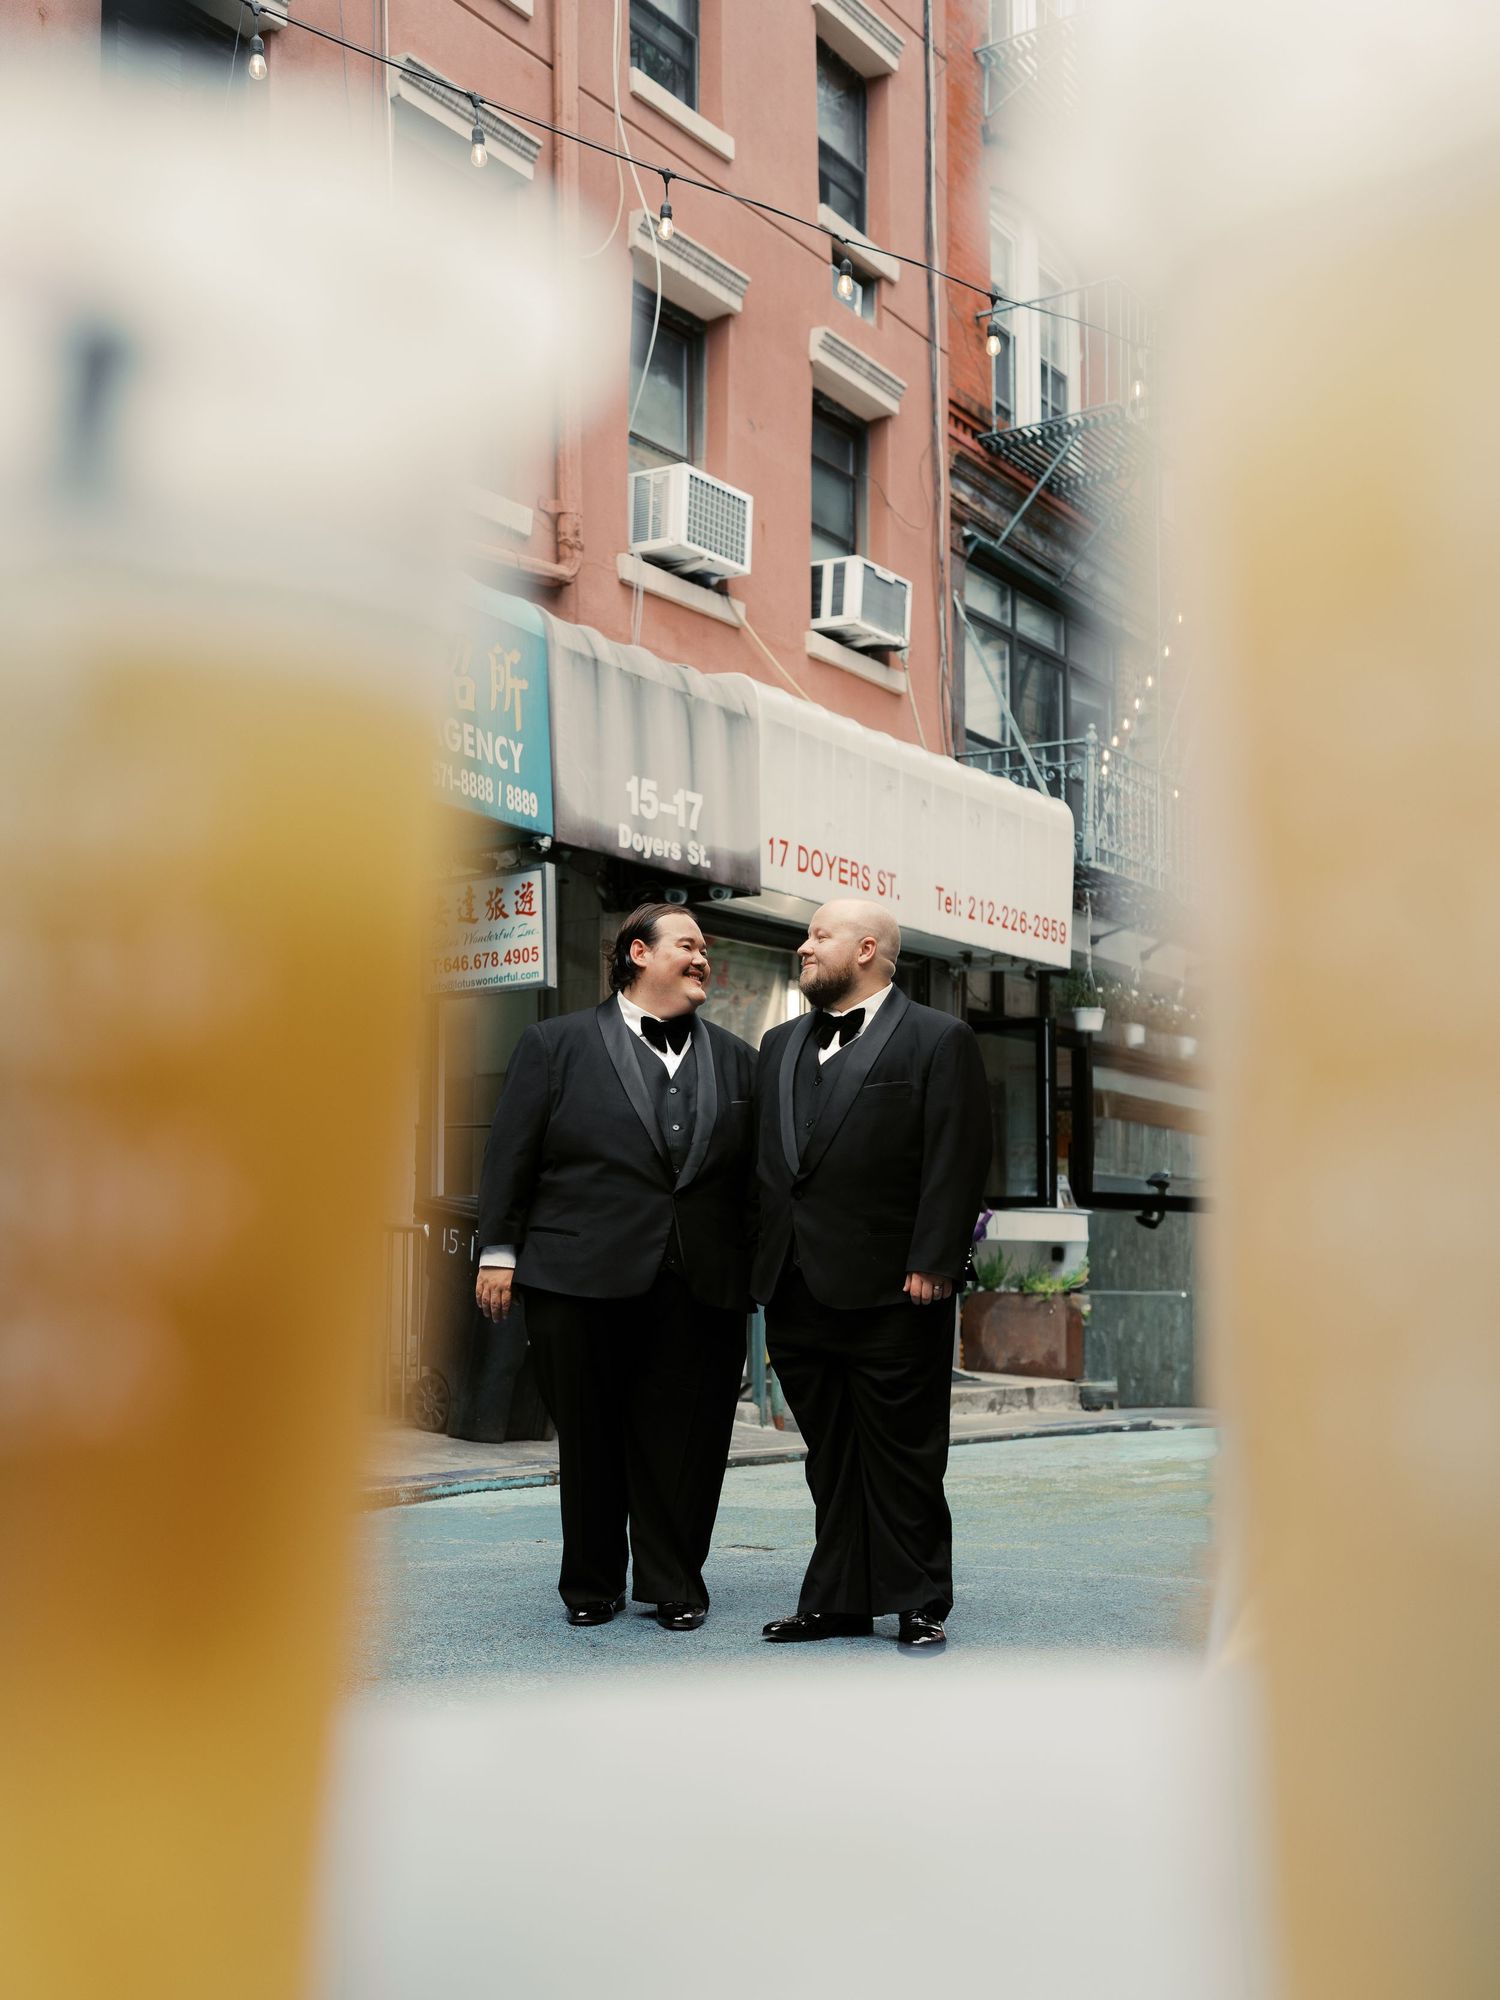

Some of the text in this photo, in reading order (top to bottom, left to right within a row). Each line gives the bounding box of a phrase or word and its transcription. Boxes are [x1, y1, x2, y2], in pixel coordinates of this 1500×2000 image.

[438, 716, 524, 774] GENCY
[506, 784, 538, 817] 8889
[625, 775, 703, 831] 15-17
[618, 823, 711, 869] Doyers St.
[769, 837, 900, 900] 17 DOYERS ST.
[464, 926, 514, 946] Wonderful
[935, 886, 1067, 944] Tel: 212-226-2959
[442, 1227, 479, 1262] 15-1
